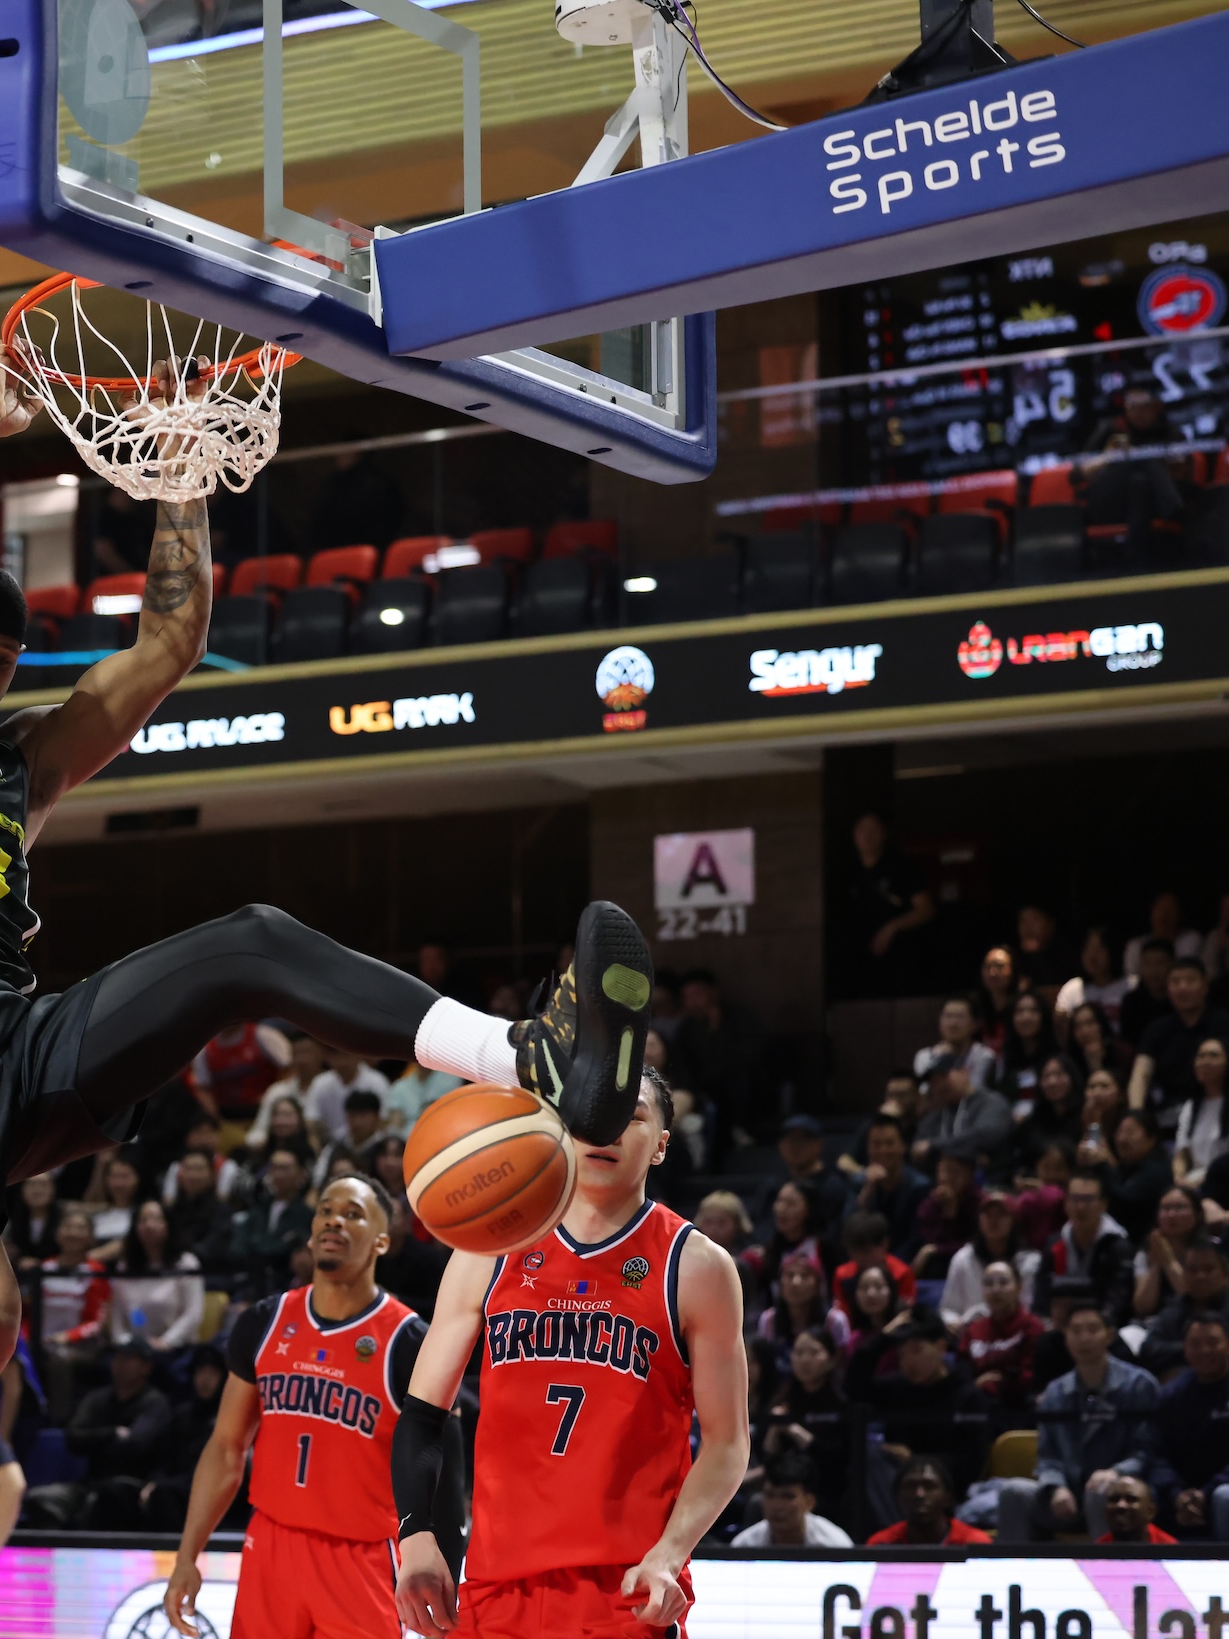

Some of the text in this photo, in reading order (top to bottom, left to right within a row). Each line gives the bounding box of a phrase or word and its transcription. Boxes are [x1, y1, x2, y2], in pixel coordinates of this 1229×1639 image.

[823, 90, 1058, 171] Schelde
[829, 132, 1066, 215] Sports
[680, 842, 728, 900] A
[657, 904, 747, 939] 22-41
[445, 1161, 515, 1208] molten
[547, 1298, 612, 1311] CHINGGIS
[292, 1361, 345, 1379] CHINGGIS
[487, 1309, 659, 1383] BRONCOS
[256, 1372, 382, 1439] BRONCOS
[545, 1383, 586, 1456] 7
[295, 1433, 313, 1488] 1
[823, 1584, 938, 1639] Get
[975, 1584, 1093, 1639] the
